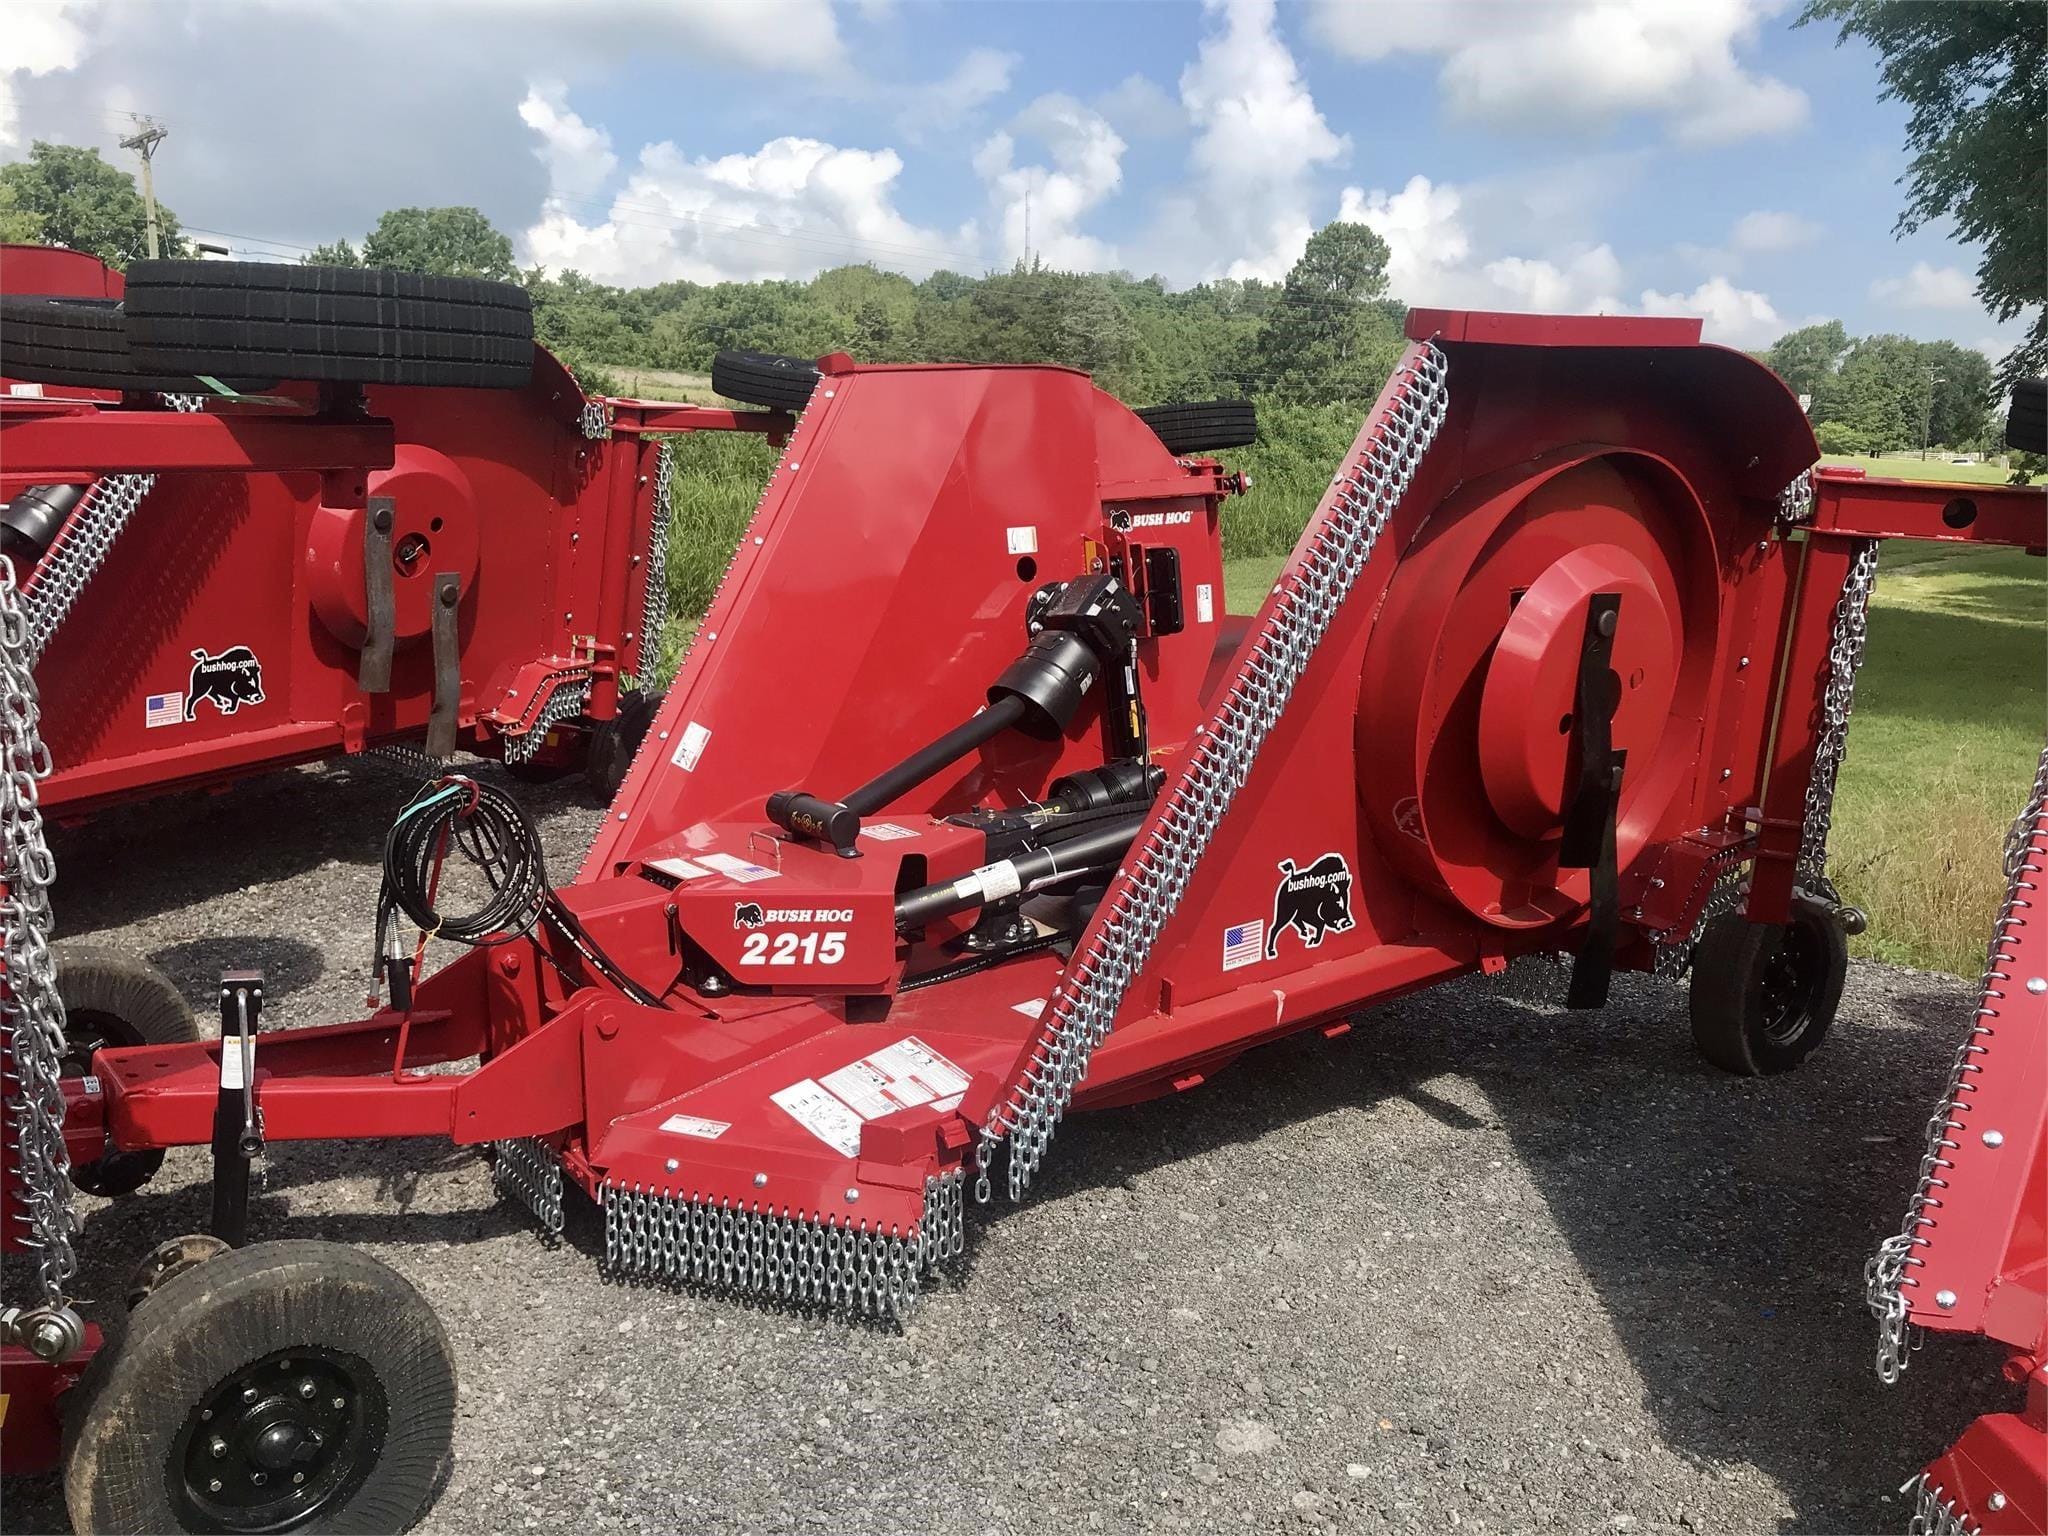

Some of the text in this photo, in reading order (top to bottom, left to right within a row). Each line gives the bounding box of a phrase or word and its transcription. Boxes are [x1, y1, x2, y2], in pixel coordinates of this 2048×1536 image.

[1133, 511, 1191, 528] BUSH HOG
[201, 656, 256, 675] bushhog.com
[1288, 869, 1347, 893] bushhog.com
[765, 908, 854, 924] BUSH HOG
[739, 931, 848, 966] 2215
